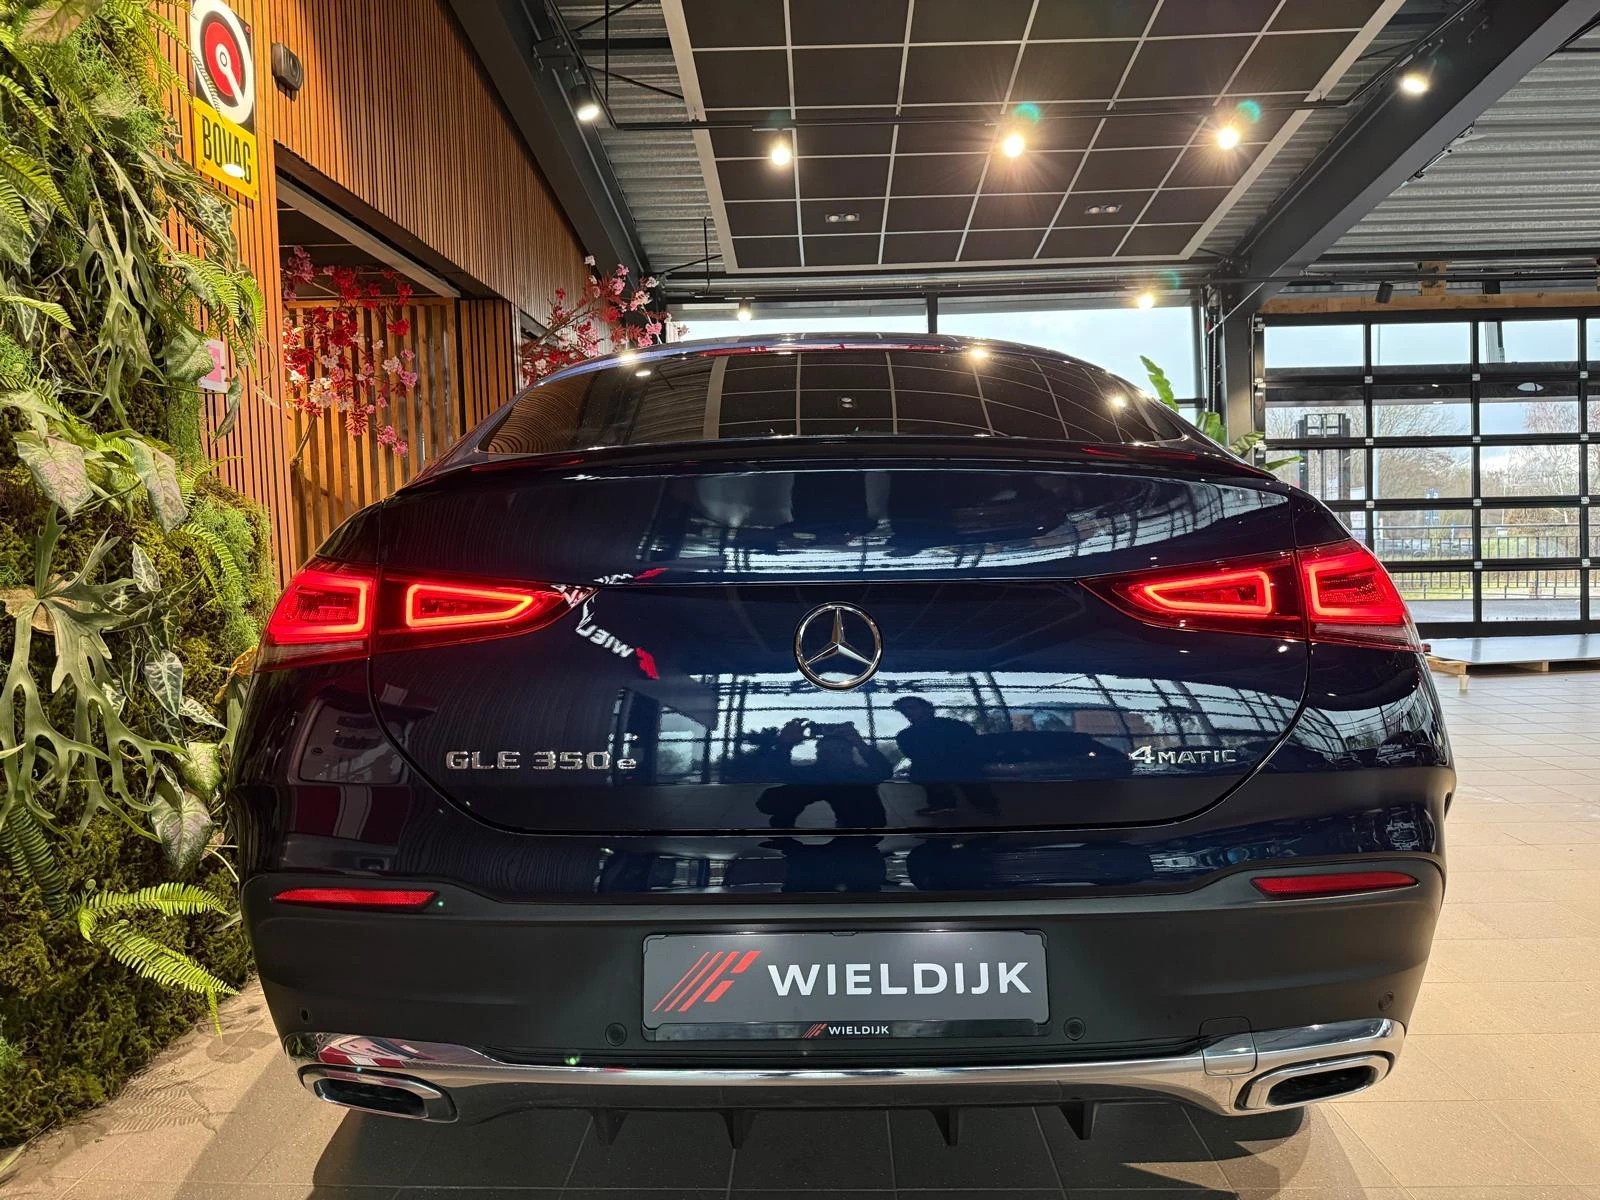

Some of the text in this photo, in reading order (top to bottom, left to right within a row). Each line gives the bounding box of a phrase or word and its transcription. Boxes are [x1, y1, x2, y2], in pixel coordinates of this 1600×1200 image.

[202, 114, 252, 185] BOVAG
[446, 751, 521, 770] GLE
[1128, 745, 1237, 764] 4MATIC
[767, 961, 1032, 996] WIELDIJK
[828, 1025, 890, 1035] WIELDIJK
